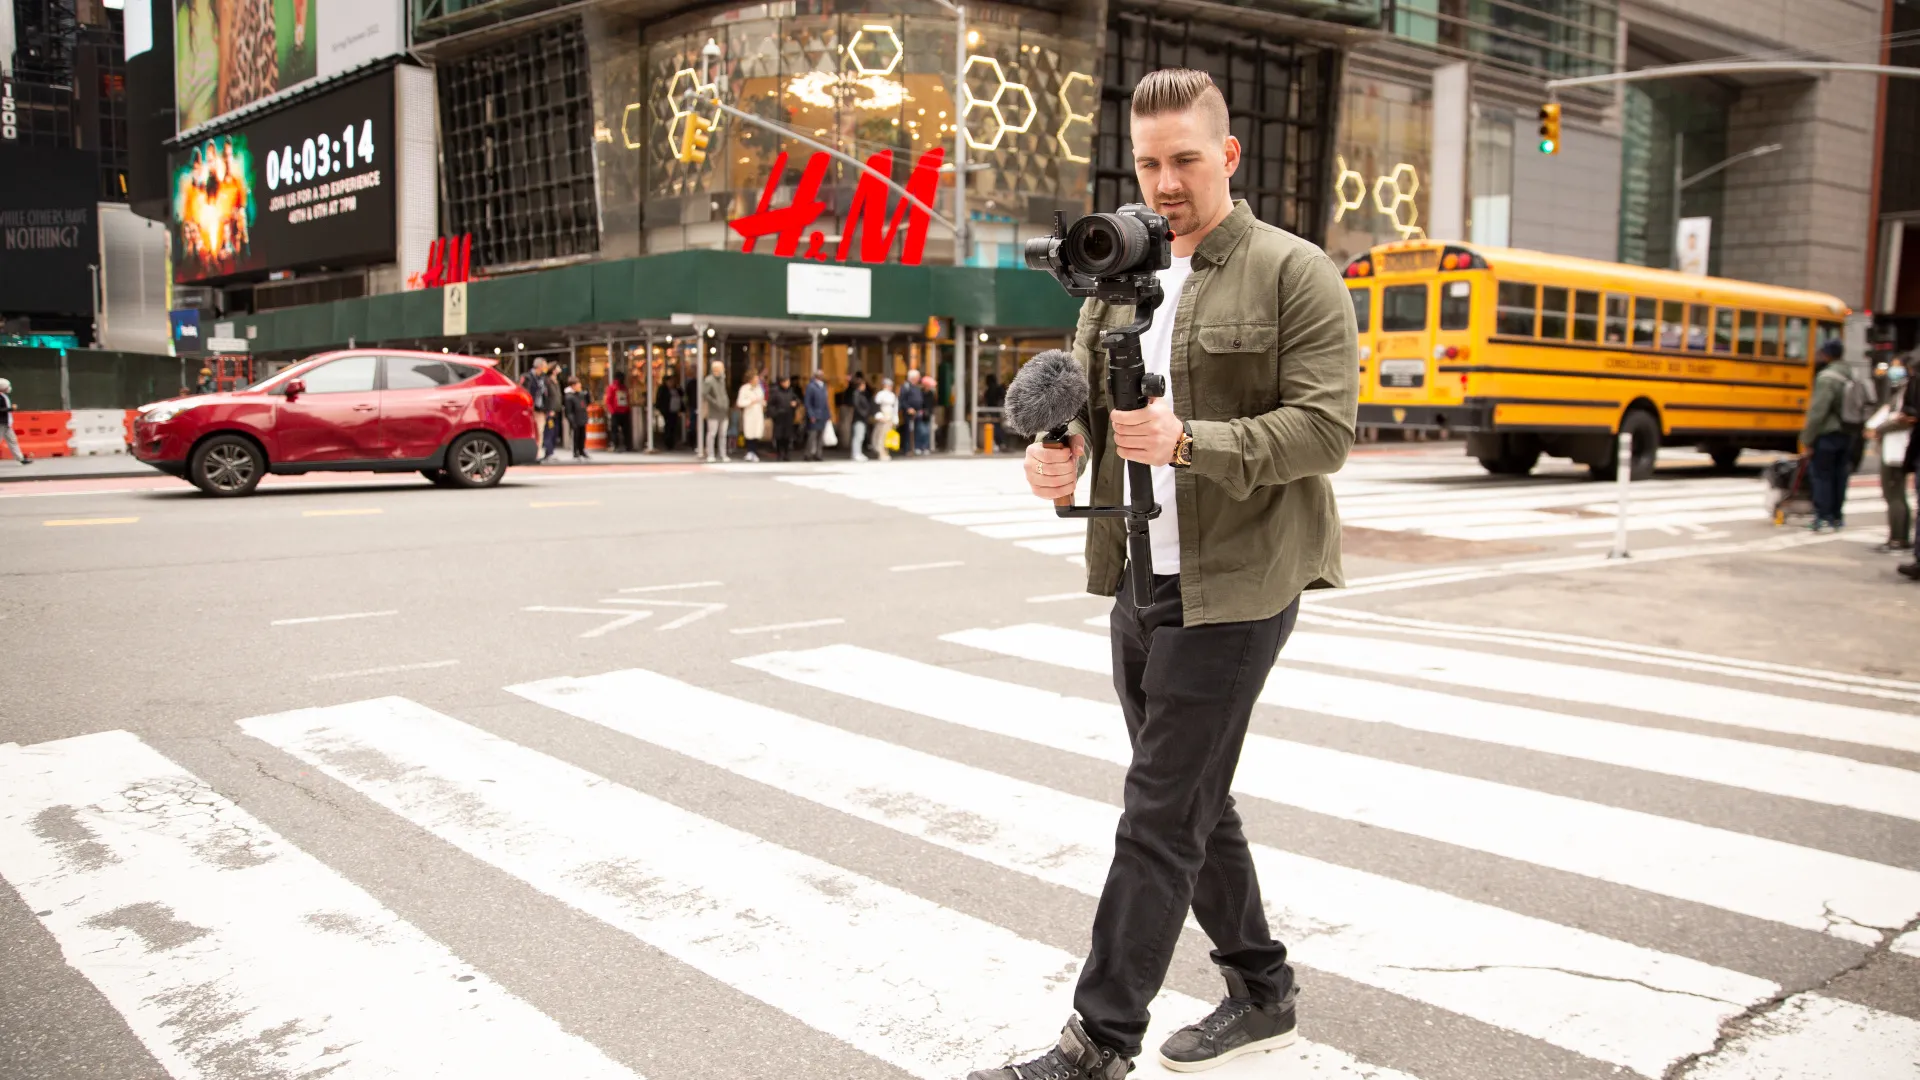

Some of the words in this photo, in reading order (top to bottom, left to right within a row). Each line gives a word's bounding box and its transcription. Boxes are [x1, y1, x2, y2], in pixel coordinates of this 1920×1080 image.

[2, 83, 17, 140] 1500
[266, 118, 375, 190] 04:03:14
[269, 195, 286, 212] JOIN
[286, 192, 297, 208] US
[297, 188, 312, 204] FOR
[313, 187, 319, 201] A
[330, 169, 381, 197] EXPERIENCE
[328, 199, 339, 216] AT
[729, 147, 945, 265] H&M
[5, 225, 80, 250] NOTHING?
[65, 207, 88, 225] HAVE
